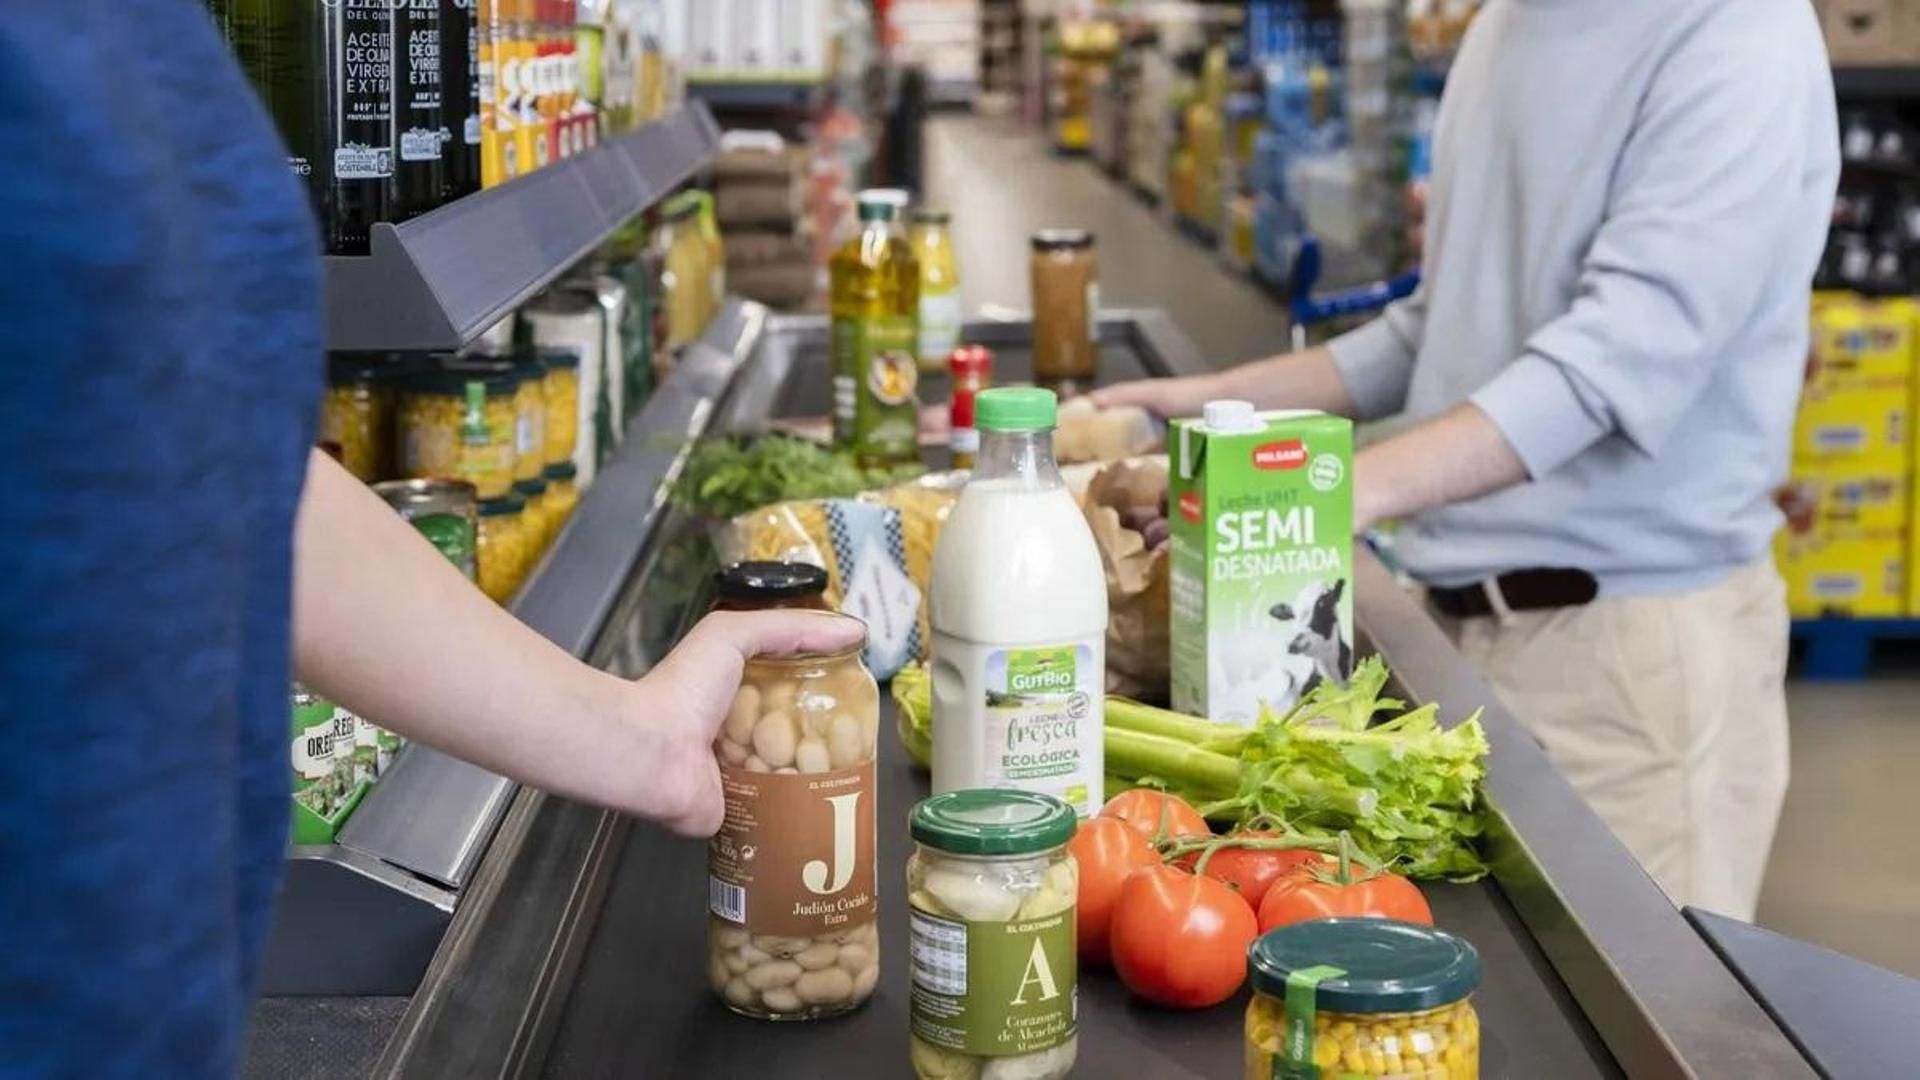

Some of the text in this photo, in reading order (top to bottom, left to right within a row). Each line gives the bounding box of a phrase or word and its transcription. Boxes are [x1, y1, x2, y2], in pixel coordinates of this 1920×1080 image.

[347, 11, 368, 20] DEL
[1215, 506, 1315, 553] SEMI
[1213, 546, 1341, 581] DESNATADA
[1001, 748, 1081, 767] ECOLÓGICA
[802, 791, 864, 895] J
[793, 901, 835, 915] Judión
[824, 913, 848, 926] Extra
[1010, 936, 1060, 1005] A
[997, 1029, 1013, 1042] de
